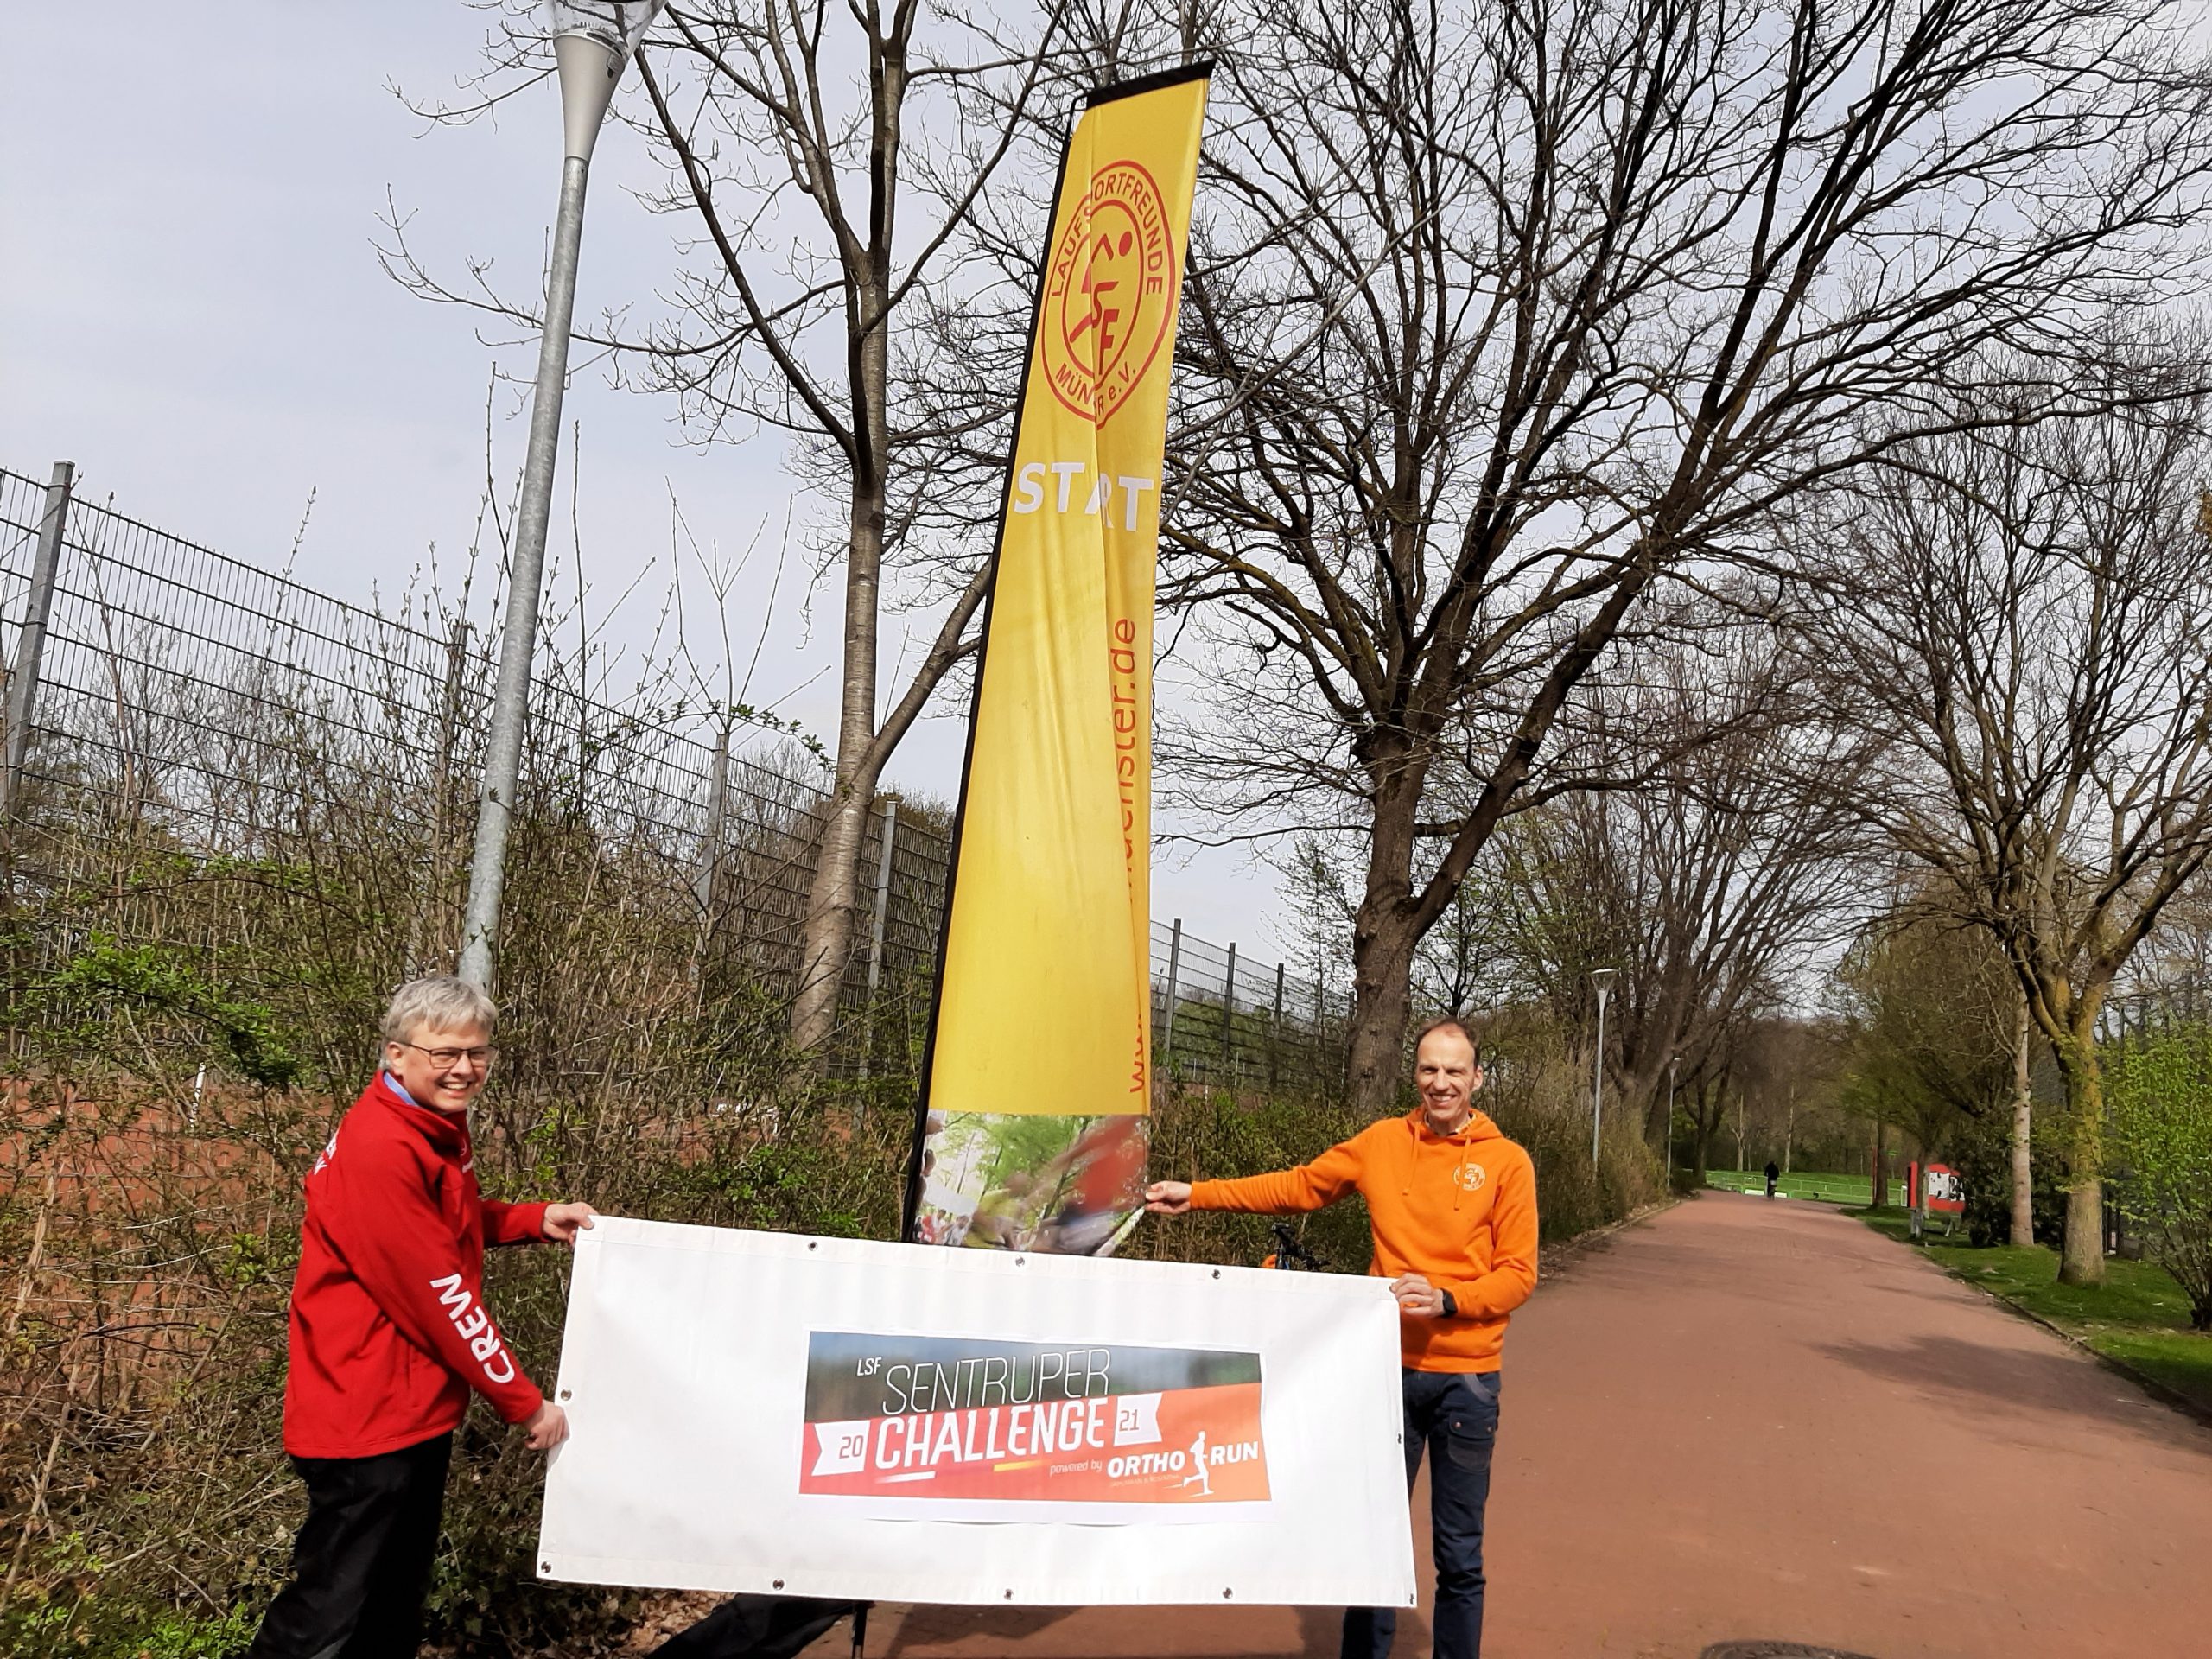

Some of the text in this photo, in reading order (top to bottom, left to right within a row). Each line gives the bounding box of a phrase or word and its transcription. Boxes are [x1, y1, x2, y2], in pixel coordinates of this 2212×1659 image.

[1052, 172, 1164, 296] LAUFSORTFREUNDE
[429, 1273, 515, 1383] CREW
[856, 1348, 1111, 1415] LSF SENTRUPER
[839, 1397, 1140, 1470] 20 CHALLENGE 21
[1049, 1440, 1259, 1478] powered by ORTHO RUN
